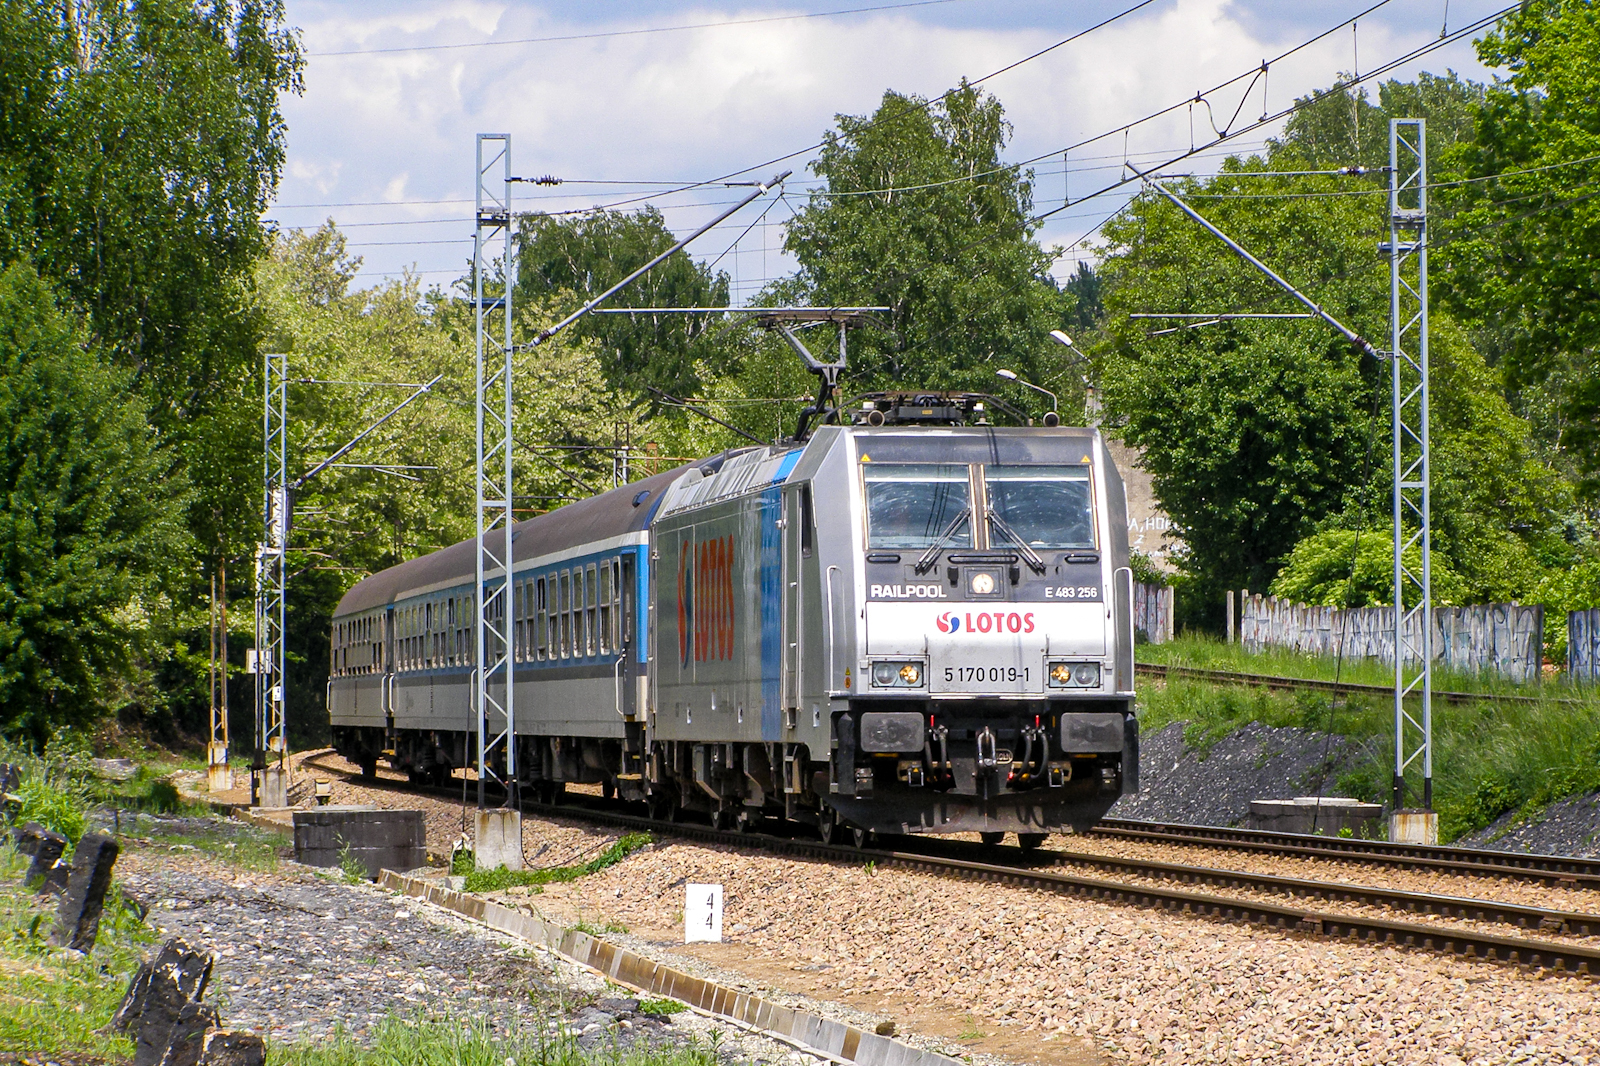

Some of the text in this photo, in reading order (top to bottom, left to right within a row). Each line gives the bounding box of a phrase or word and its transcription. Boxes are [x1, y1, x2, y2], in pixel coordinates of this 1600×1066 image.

[870, 584, 948, 598] RAILPOOL
[1044, 586, 1098, 598] E 483 256
[965, 612, 1035, 634] LOTOS
[944, 667, 1030, 682] 5 170 019-1
[706, 892, 714, 910] 4
[705, 912, 713, 930] 4
